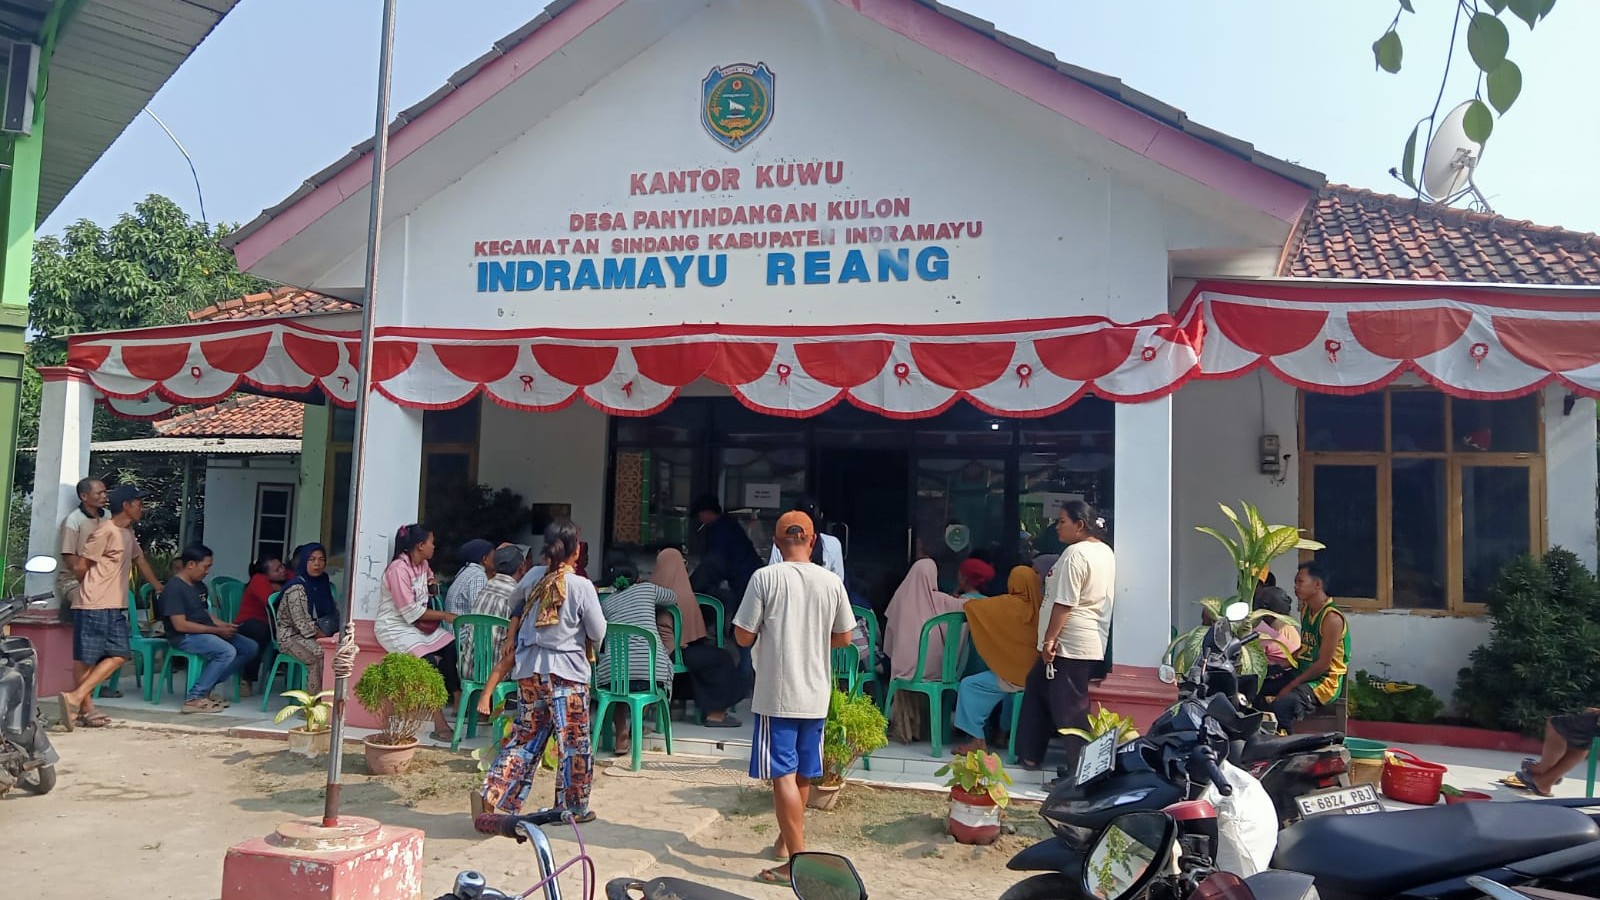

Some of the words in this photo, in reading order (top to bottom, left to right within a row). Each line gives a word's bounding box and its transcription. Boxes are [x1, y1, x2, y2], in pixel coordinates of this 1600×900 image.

[630, 168, 740, 196] KANTOR
[756, 161, 844, 189] KUWU
[569, 212, 627, 232] DESA
[633, 203, 817, 230] PANYINDANGAN
[828, 197, 910, 221] KULON
[474, 238, 600, 257] KECAMATAN
[611, 235, 700, 254] SINDANG
[845, 221, 983, 245] INDRAMAYU
[477, 254, 728, 293] INDRAMAYU
[766, 246, 950, 286] REANG
[1302, 801, 1312, 814] E
[1317, 794, 1346, 810] 6824
[1350, 788, 1373, 803] PBJ
